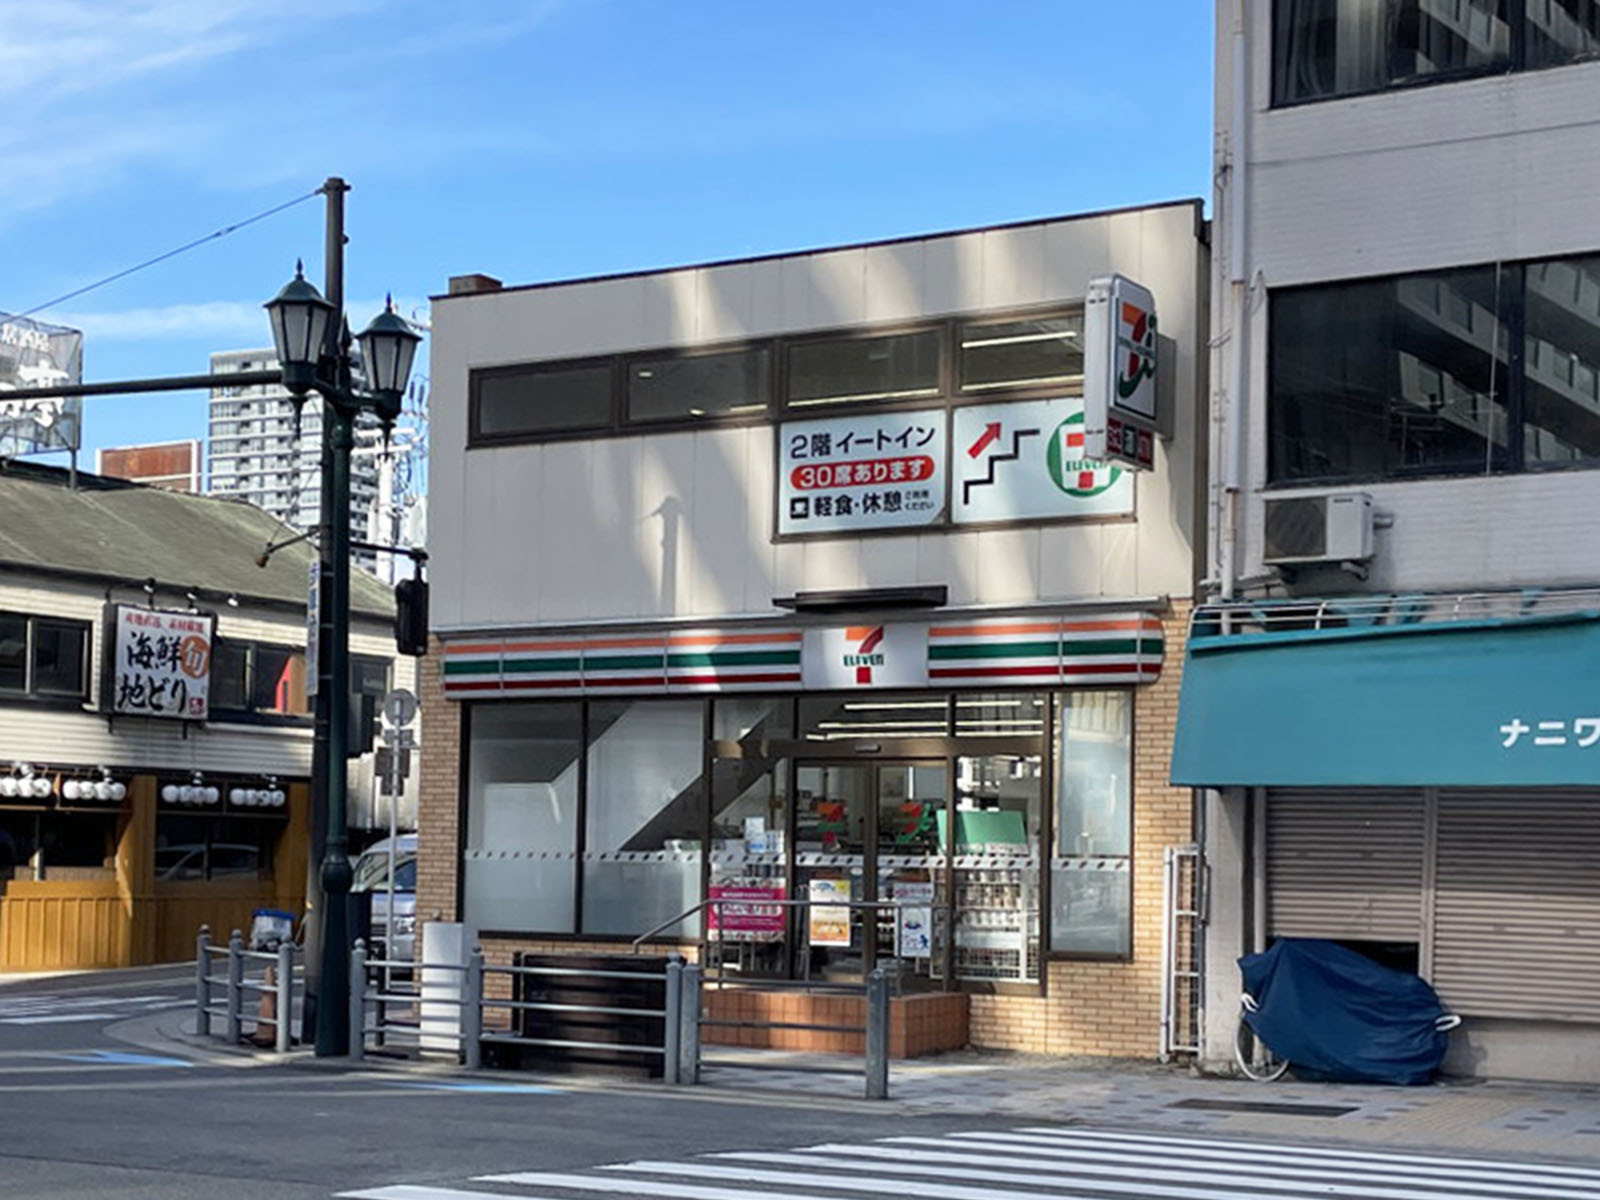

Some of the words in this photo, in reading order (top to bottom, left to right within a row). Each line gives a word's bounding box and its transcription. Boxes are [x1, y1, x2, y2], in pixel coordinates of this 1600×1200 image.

[800, 459, 926, 488] 30席あります
[127, 631, 182, 672] 海鮮
[118, 674, 187, 713] 地どり
[1500, 719, 1600, 747] ナニワ
